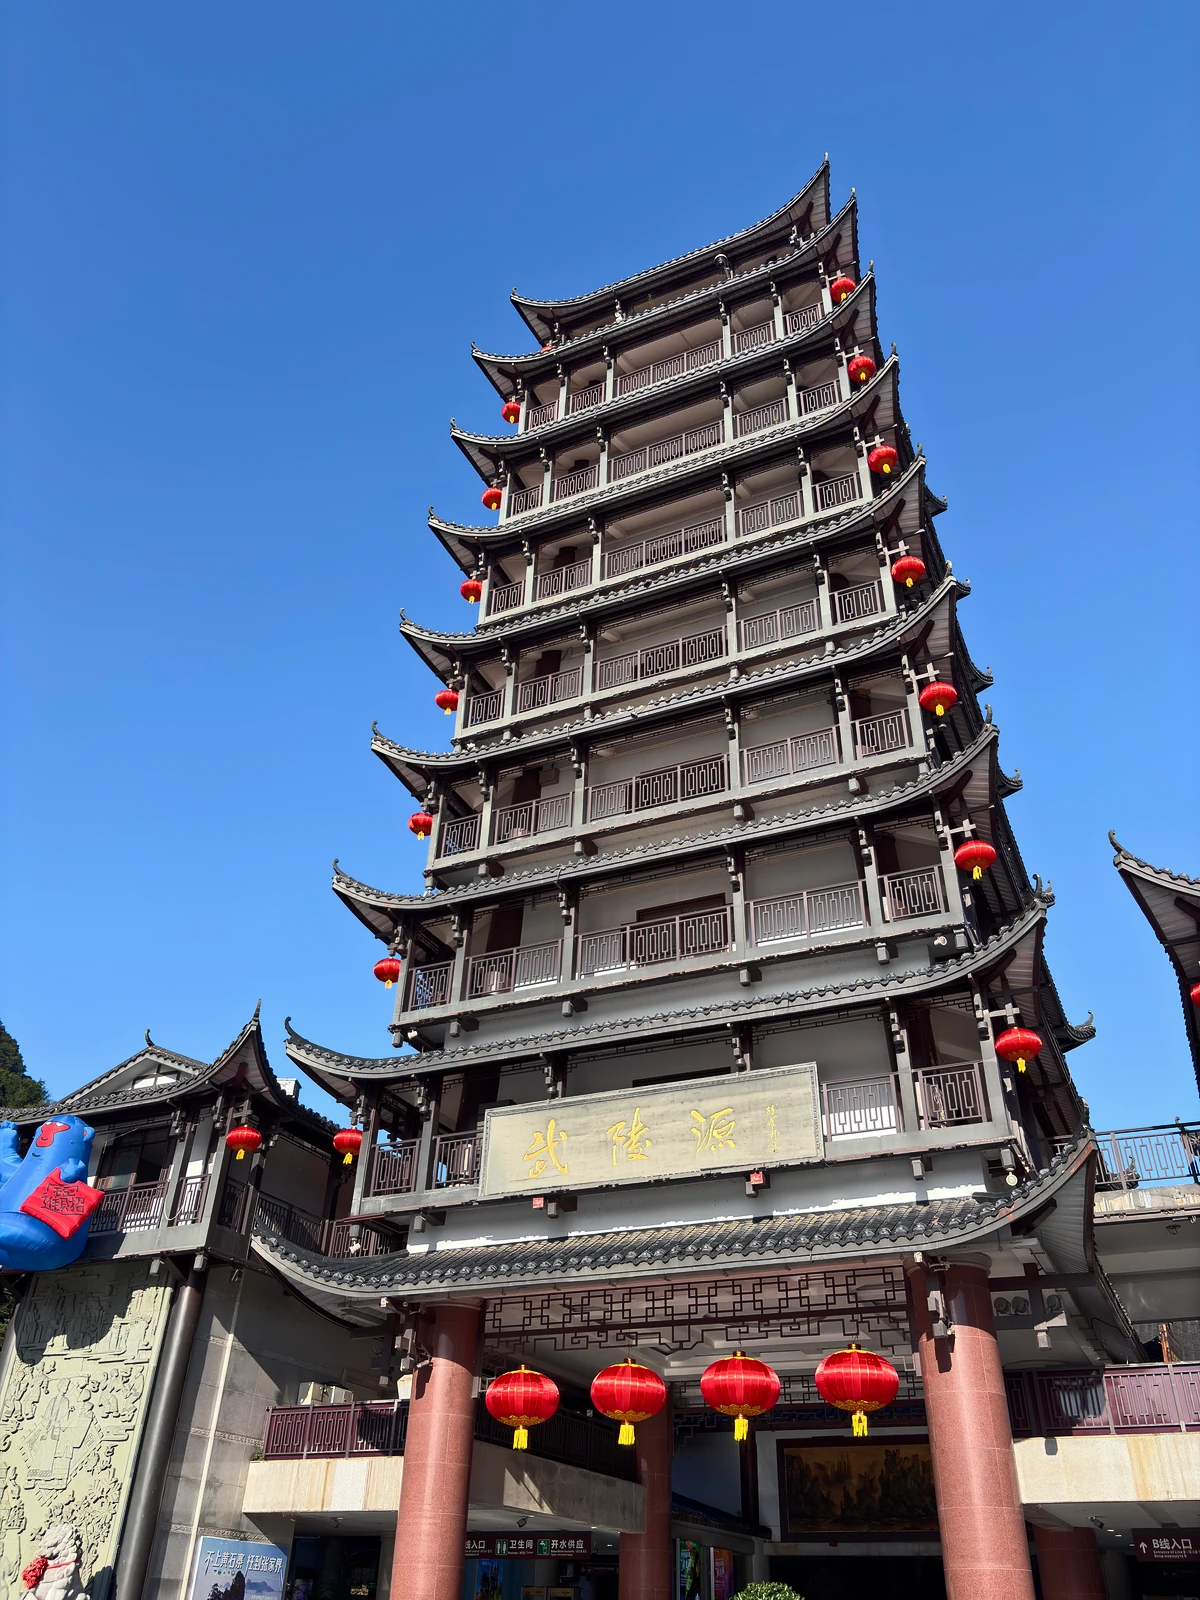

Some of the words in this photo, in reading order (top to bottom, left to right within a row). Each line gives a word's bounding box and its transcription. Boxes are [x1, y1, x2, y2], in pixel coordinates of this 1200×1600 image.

[523, 1106, 735, 1179] 武陵源
[509, 1539, 534, 1549] 卫生间
[551, 1539, 584, 1549] 开水供应
[1152, 1538, 1192, 1549] B线入口
[204, 1550, 245, 1574] 不上黄石寨
[246, 1554, 283, 1575] 枉到张家界
